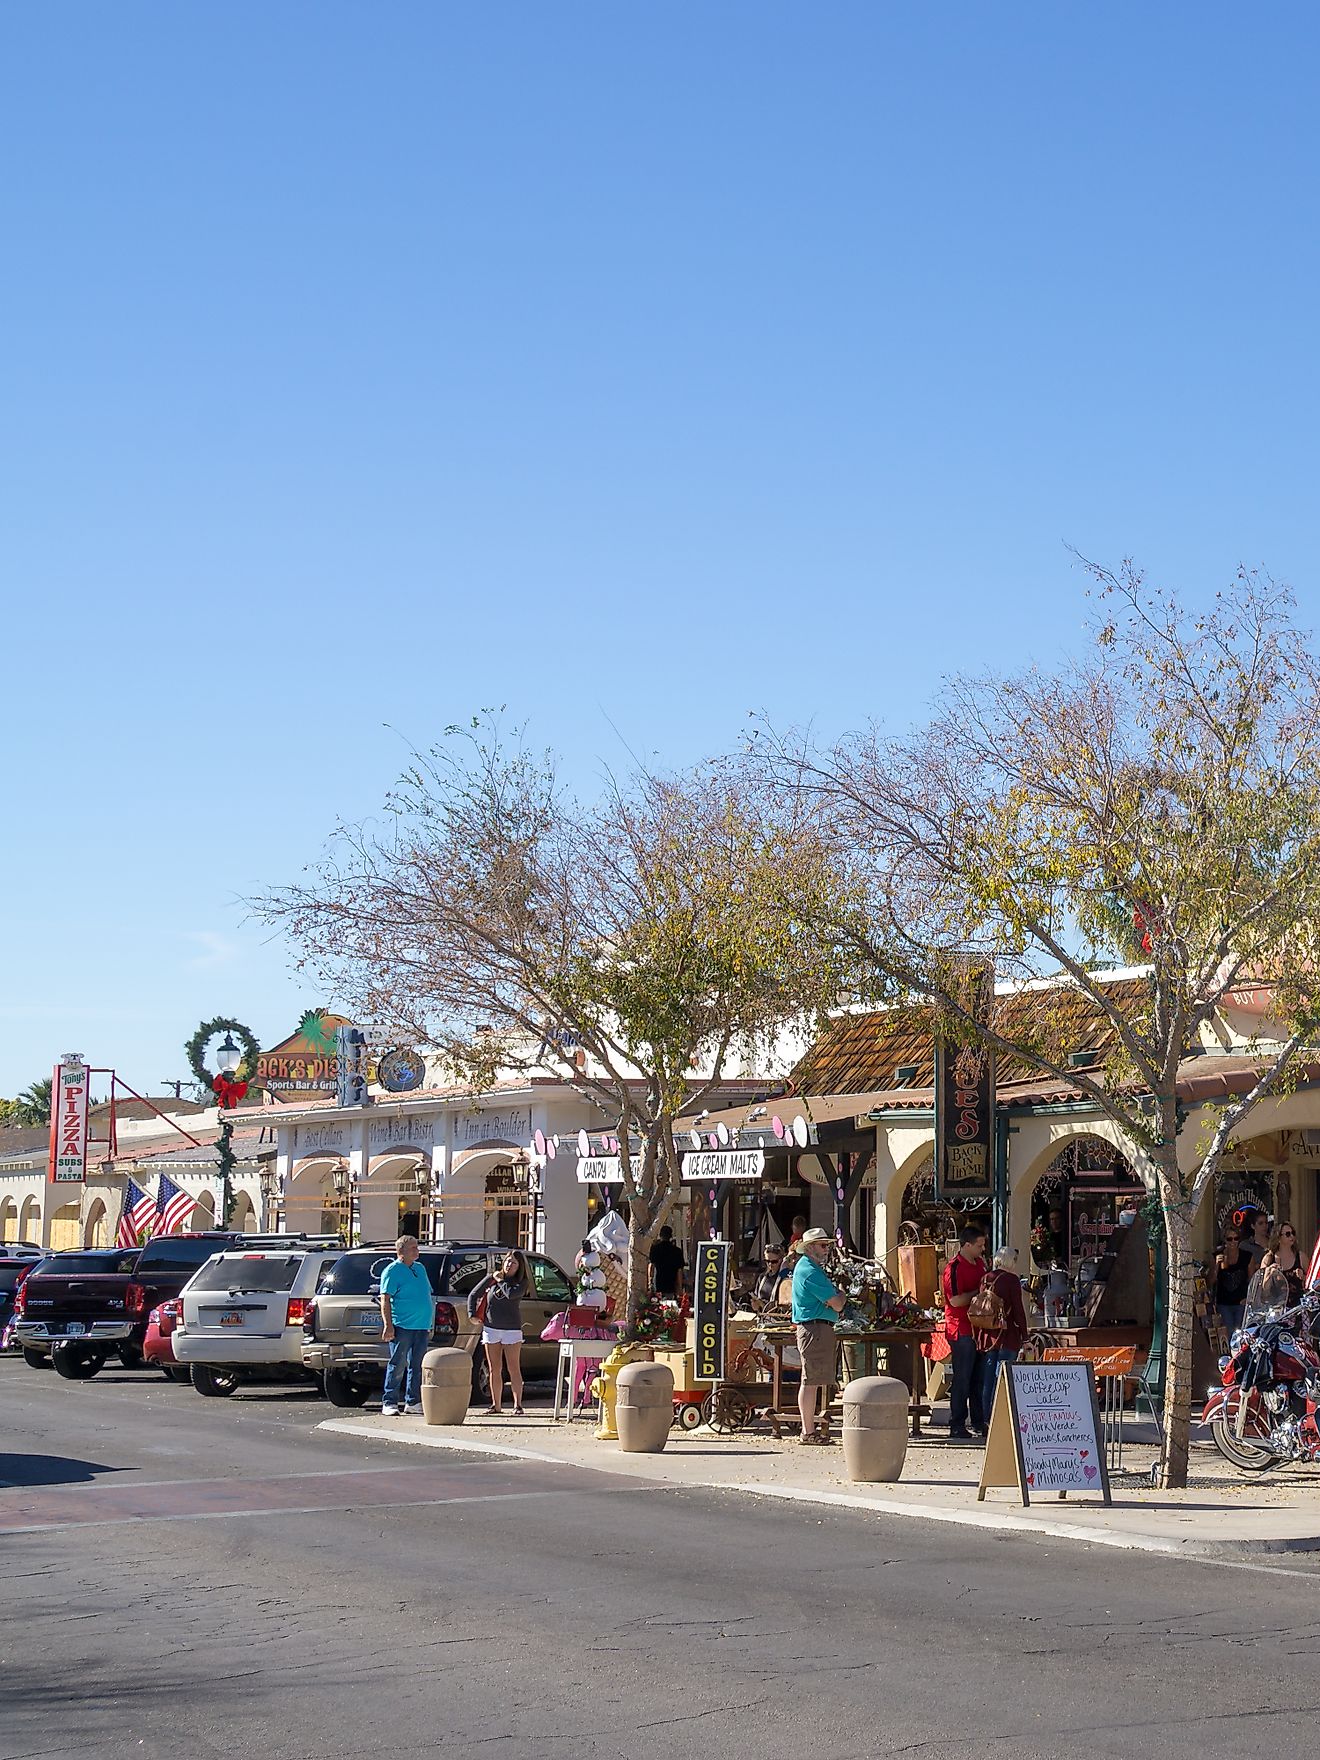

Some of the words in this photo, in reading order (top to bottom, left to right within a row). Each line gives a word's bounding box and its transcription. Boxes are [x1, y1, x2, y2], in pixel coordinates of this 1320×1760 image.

[1232, 991, 1255, 1006] BUY
[61, 1071, 86, 1086] Tony's
[266, 1080, 295, 1091] Sports
[296, 1080, 311, 1090] Bar
[312, 1081, 319, 1090] &
[60, 1087, 83, 1156] PIZZA
[493, 1111, 527, 1139] Boulder
[952, 1145, 982, 1162] BACK
[58, 1159, 83, 1167] SUBS
[688, 1154, 700, 1176] ICE
[701, 1154, 727, 1176] CREAM
[730, 1153, 759, 1176] MALTS
[963, 1157, 973, 1167] IN
[57, 1173, 82, 1181] PASTA
[584, 1161, 607, 1179] CANDY
[951, 1163, 984, 1181] THYME
[703, 1248, 719, 1304] CASH
[702, 1323, 716, 1375] GOLD
[1044, 1371, 1081, 1382] Famous
[1022, 1382, 1054, 1395] Coffee
[1054, 1382, 1071, 1396] Cup
[1036, 1394, 1063, 1405] Cafe
[1031, 1421, 1050, 1433] Pork
[1050, 1421, 1078, 1431] Verde
[1032, 1433, 1055, 1445] Huevos
[1055, 1433, 1094, 1444] Rancheros
[1025, 1457, 1052, 1473] Bloody
